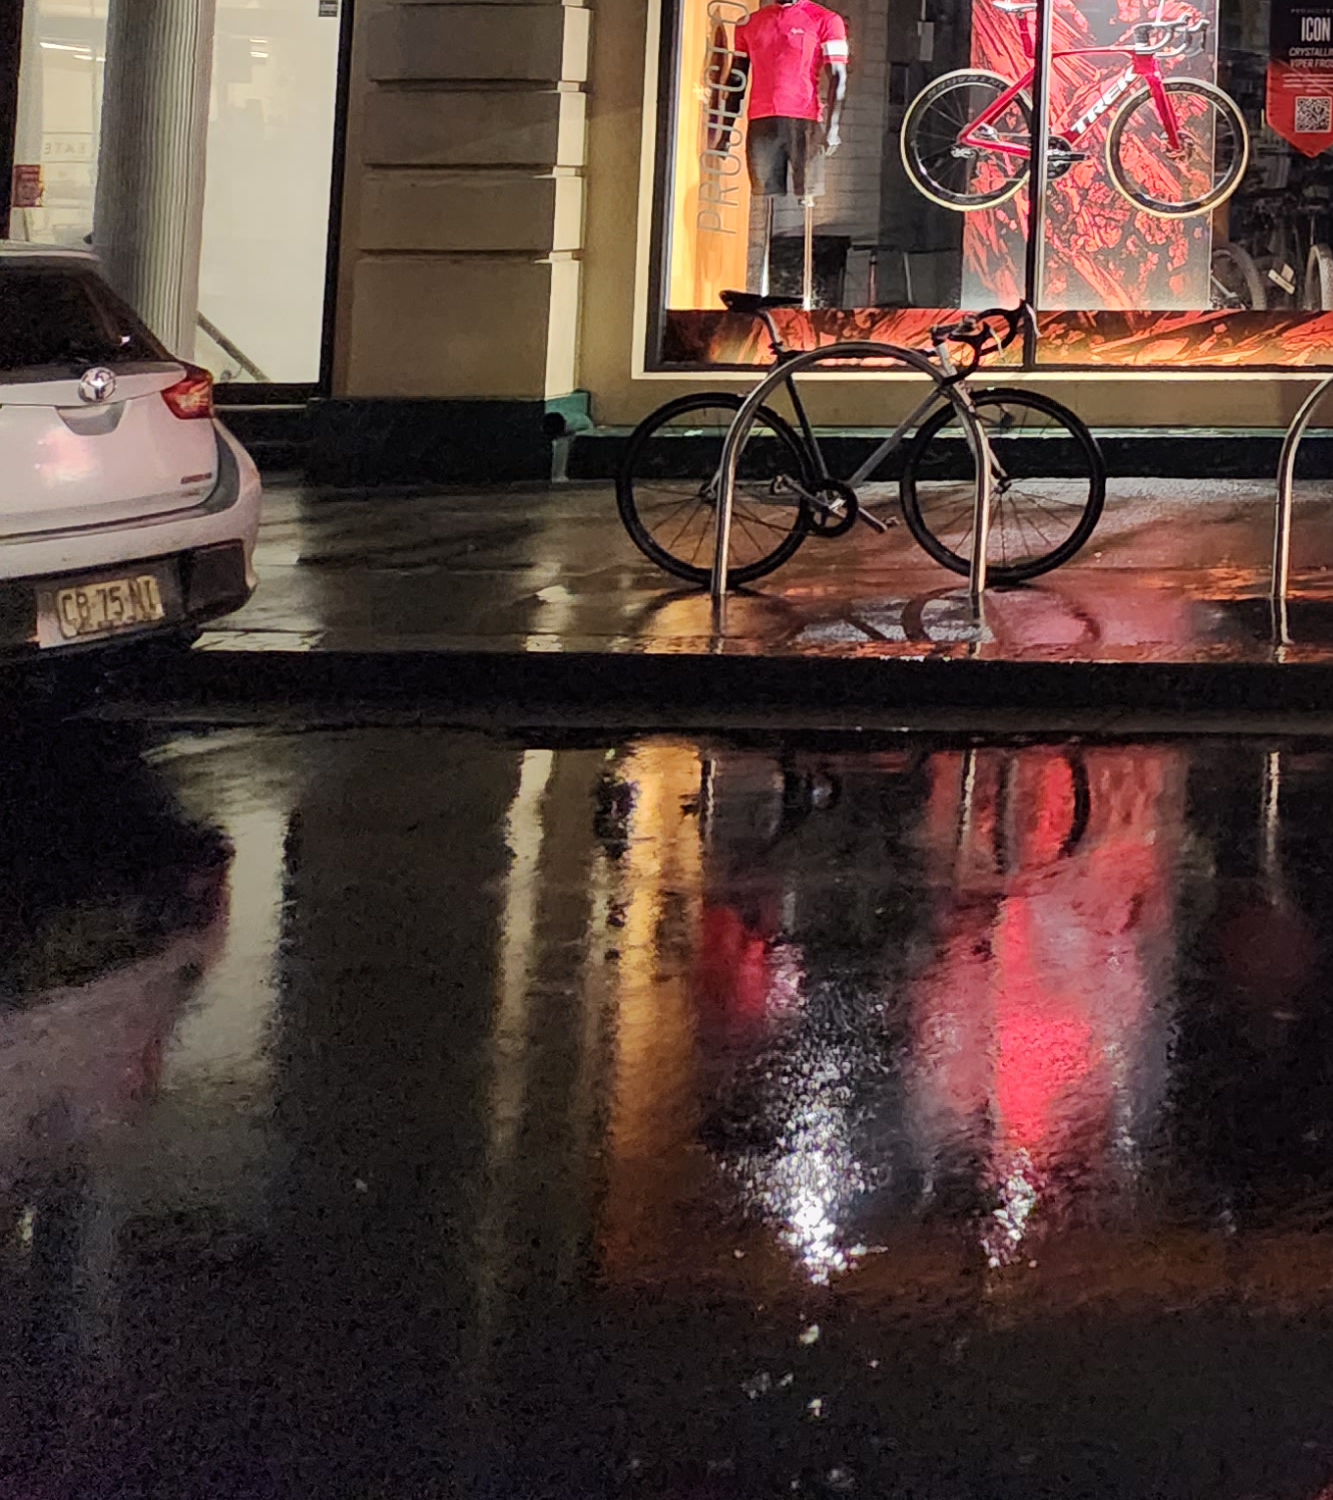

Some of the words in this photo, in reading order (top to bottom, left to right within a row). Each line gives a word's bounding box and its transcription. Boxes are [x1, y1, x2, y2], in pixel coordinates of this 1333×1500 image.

[1301, 16, 1331, 42] ICON
[1290, 59, 1314, 68] VIPER
[1070, 64, 1138, 134] TREK
[697, 37, 748, 235] PROJECT
